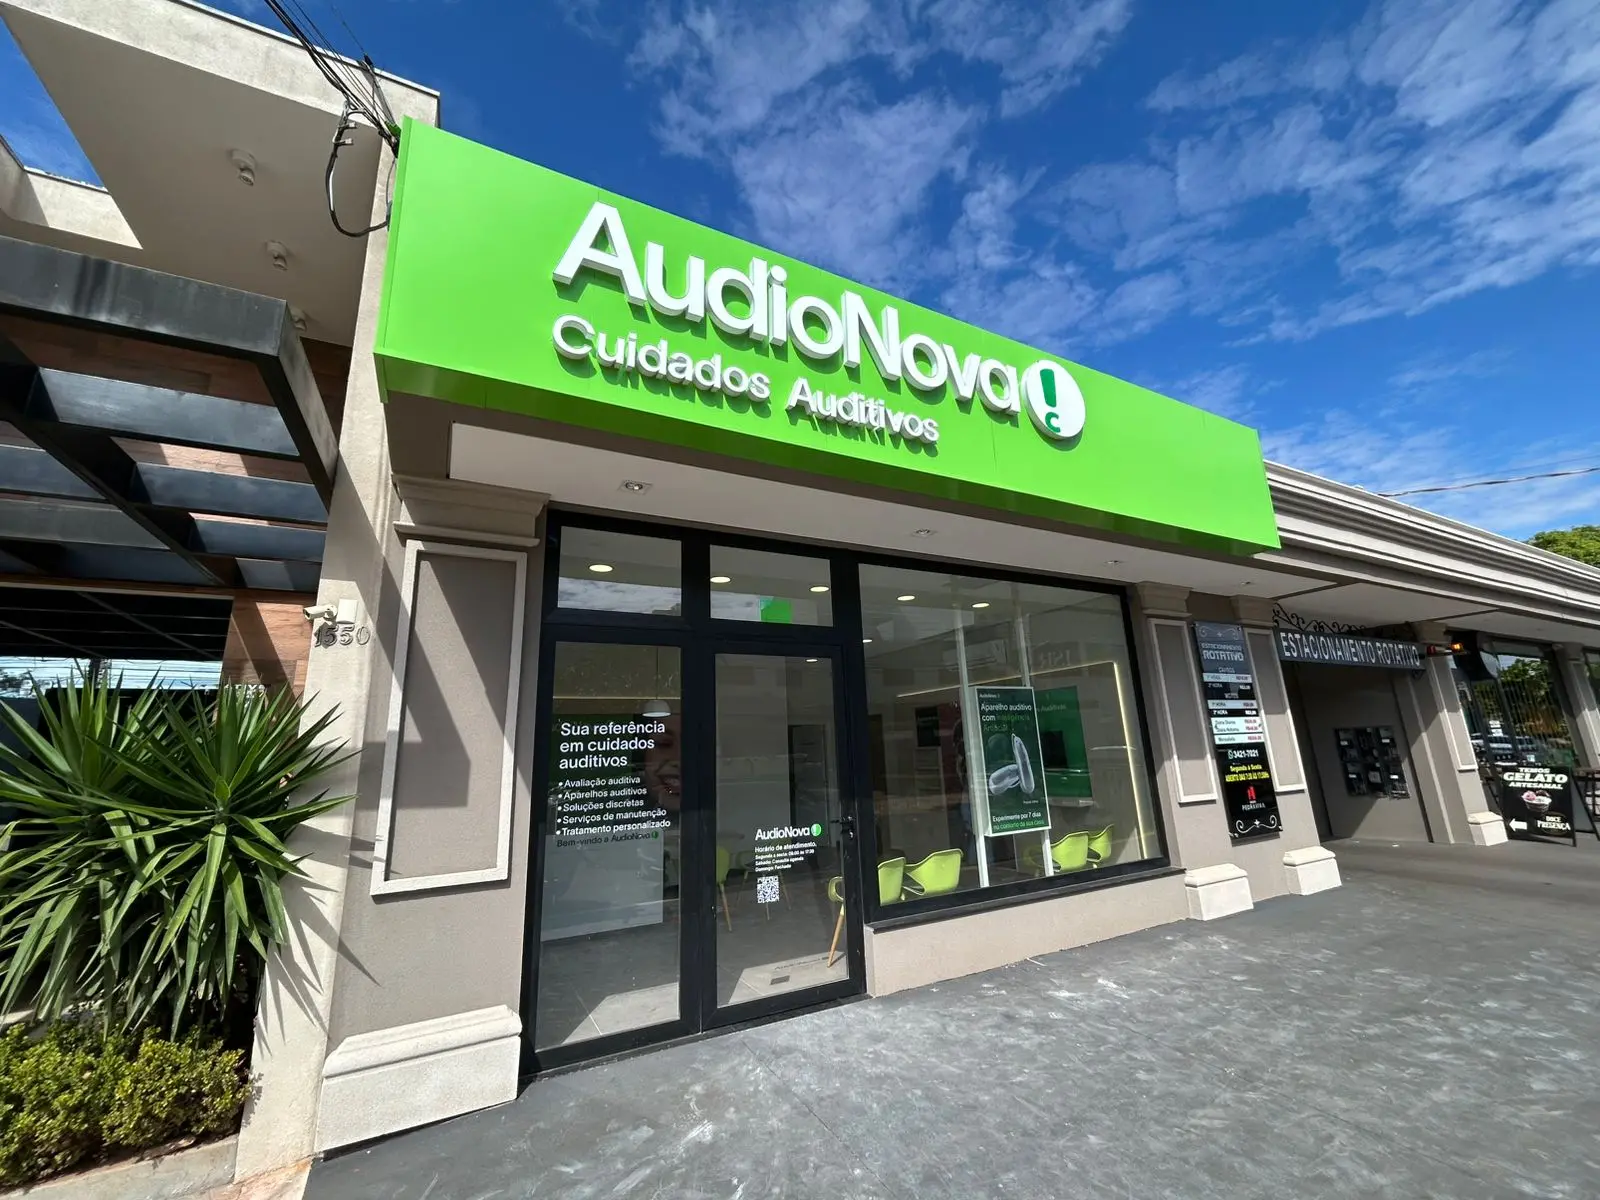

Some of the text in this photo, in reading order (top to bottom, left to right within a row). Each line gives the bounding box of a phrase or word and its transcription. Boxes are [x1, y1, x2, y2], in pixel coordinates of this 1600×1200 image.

[552, 200, 1021, 416] AudioNova
[552, 314, 940, 444] Cuidados Auditivos
[314, 624, 371, 647] 1550
[1203, 649, 1244, 661] ROTATIVO
[1280, 632, 1420, 666] ESTACIONAMENTO ROTATIVO
[560, 721, 665, 736] Sua referência
[560, 737, 655, 753] em cuidados
[559, 754, 628, 769] auditivos
[563, 775, 641, 788] Avaliação auditiva
[1503, 772, 1568, 783] GELATO
[1508, 781, 1564, 790] ARTESANAL
[563, 787, 647, 800] Aparelhos auditivos
[563, 798, 644, 812] Soluções discretas
[562, 807, 667, 824] Serviços de manutenção
[562, 819, 671, 836] Tratamento personalizado
[755, 826, 810, 841] AudioNova
[556, 836, 603, 848] Bem-vindo
[611, 833, 651, 843] AudioNova
[755, 845, 775, 853] Horário
